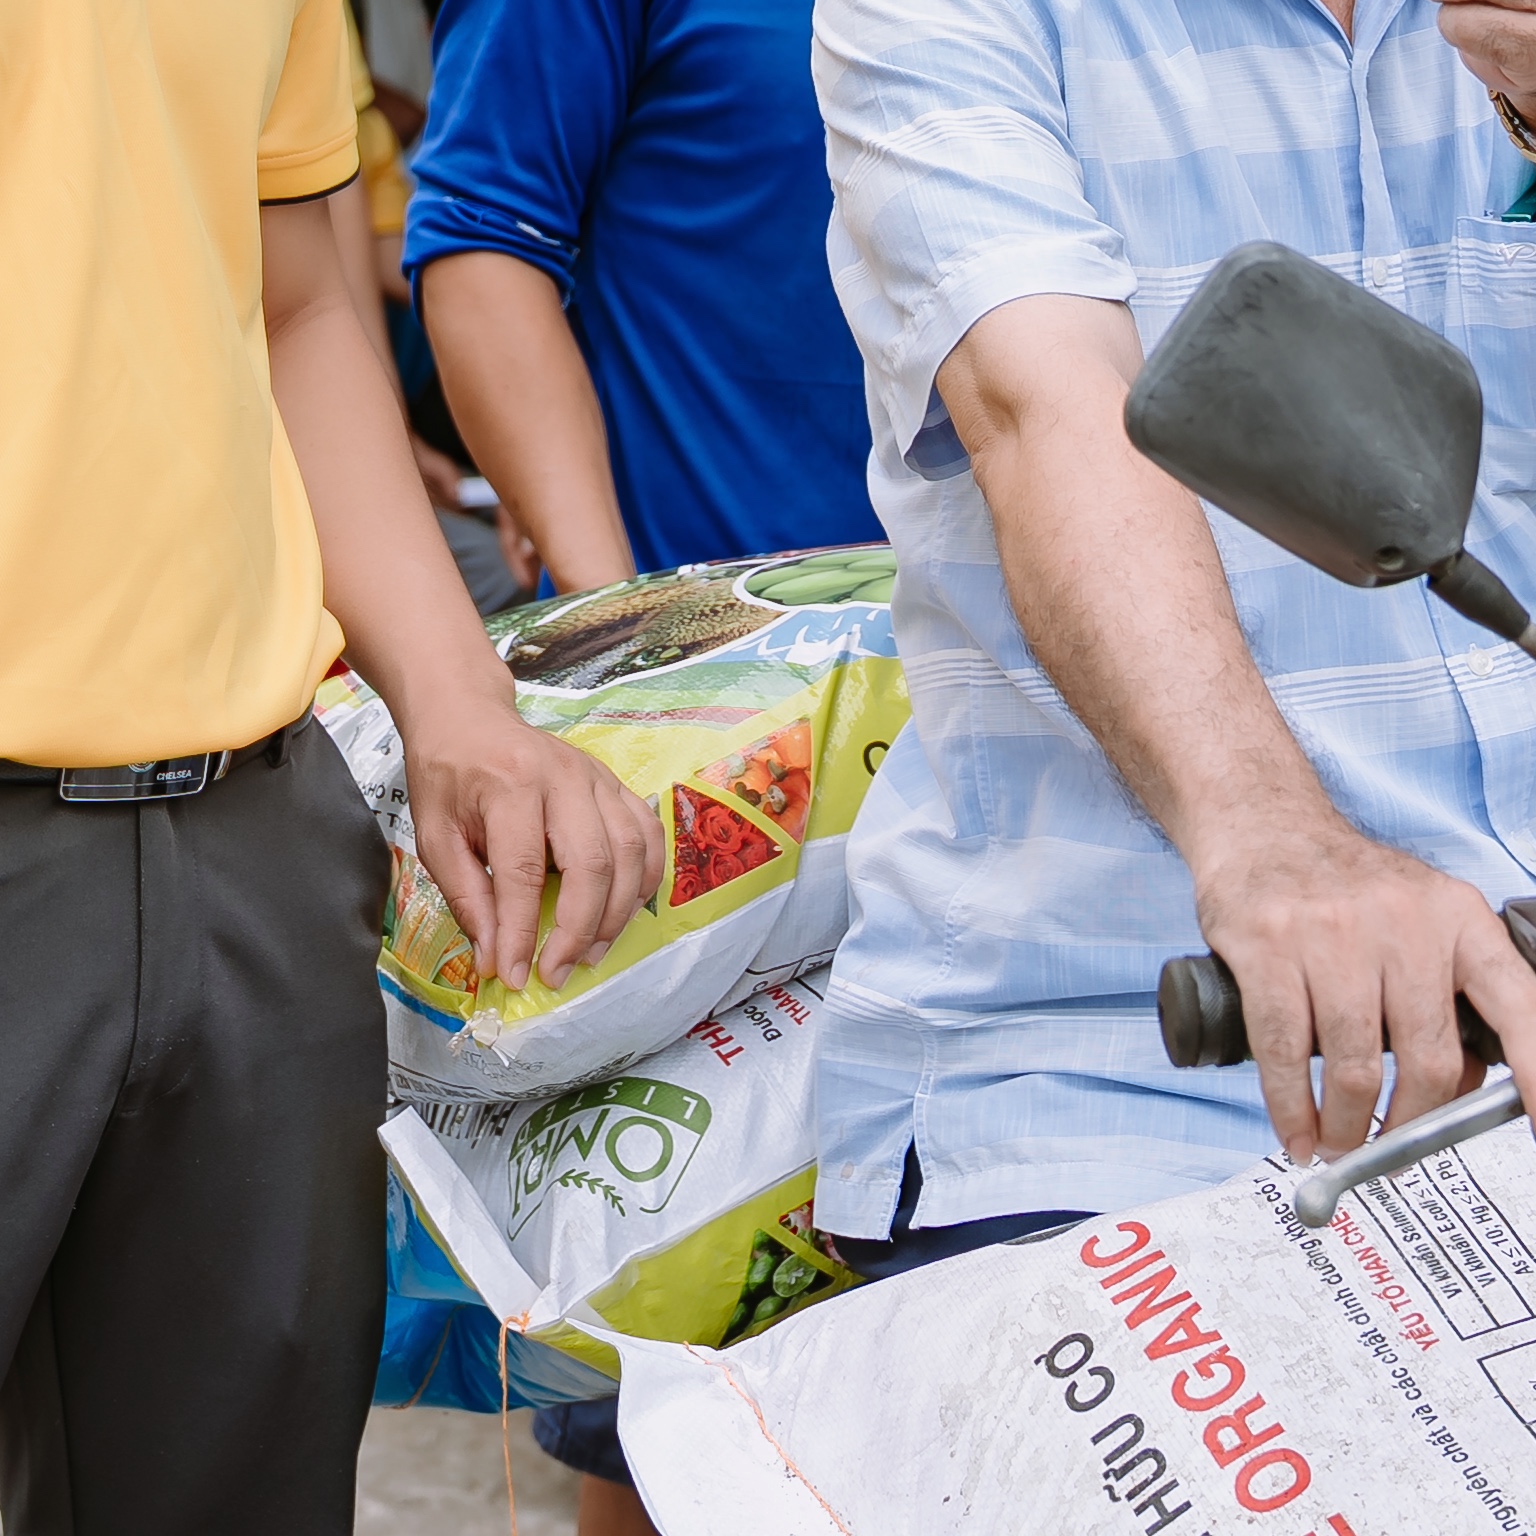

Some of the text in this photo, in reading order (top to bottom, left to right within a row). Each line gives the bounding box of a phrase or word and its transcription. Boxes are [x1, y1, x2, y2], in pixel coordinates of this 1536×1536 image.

[156, 769, 193, 782] CHELSEA
[511, 1107, 674, 1220] OMRI
[1254, 1183, 1281, 1206] có
[1274, 1202, 1309, 1243] khác
[1358, 1246, 1392, 1284] HẠN
[1406, 1242, 1452, 1288] khuẩn
[1445, 1232, 1486, 1272] khuẩn
[1377, 1277, 1410, 1312] TỐ
[1439, 1280, 1463, 1299] Vi
[1356, 1326, 1398, 1364] chất
[1402, 1313, 1438, 1350] YẾU
[1079, 1221, 1311, 1513] ORGANIC
[1390, 1367, 1422, 1400] các
[1411, 1403, 1438, 1426] và
[1033, 1332, 1193, 1536] HỮU CƠ
[1424, 1425, 1468, 1463] chất
[1462, 1465, 1526, 1532] nguyên
